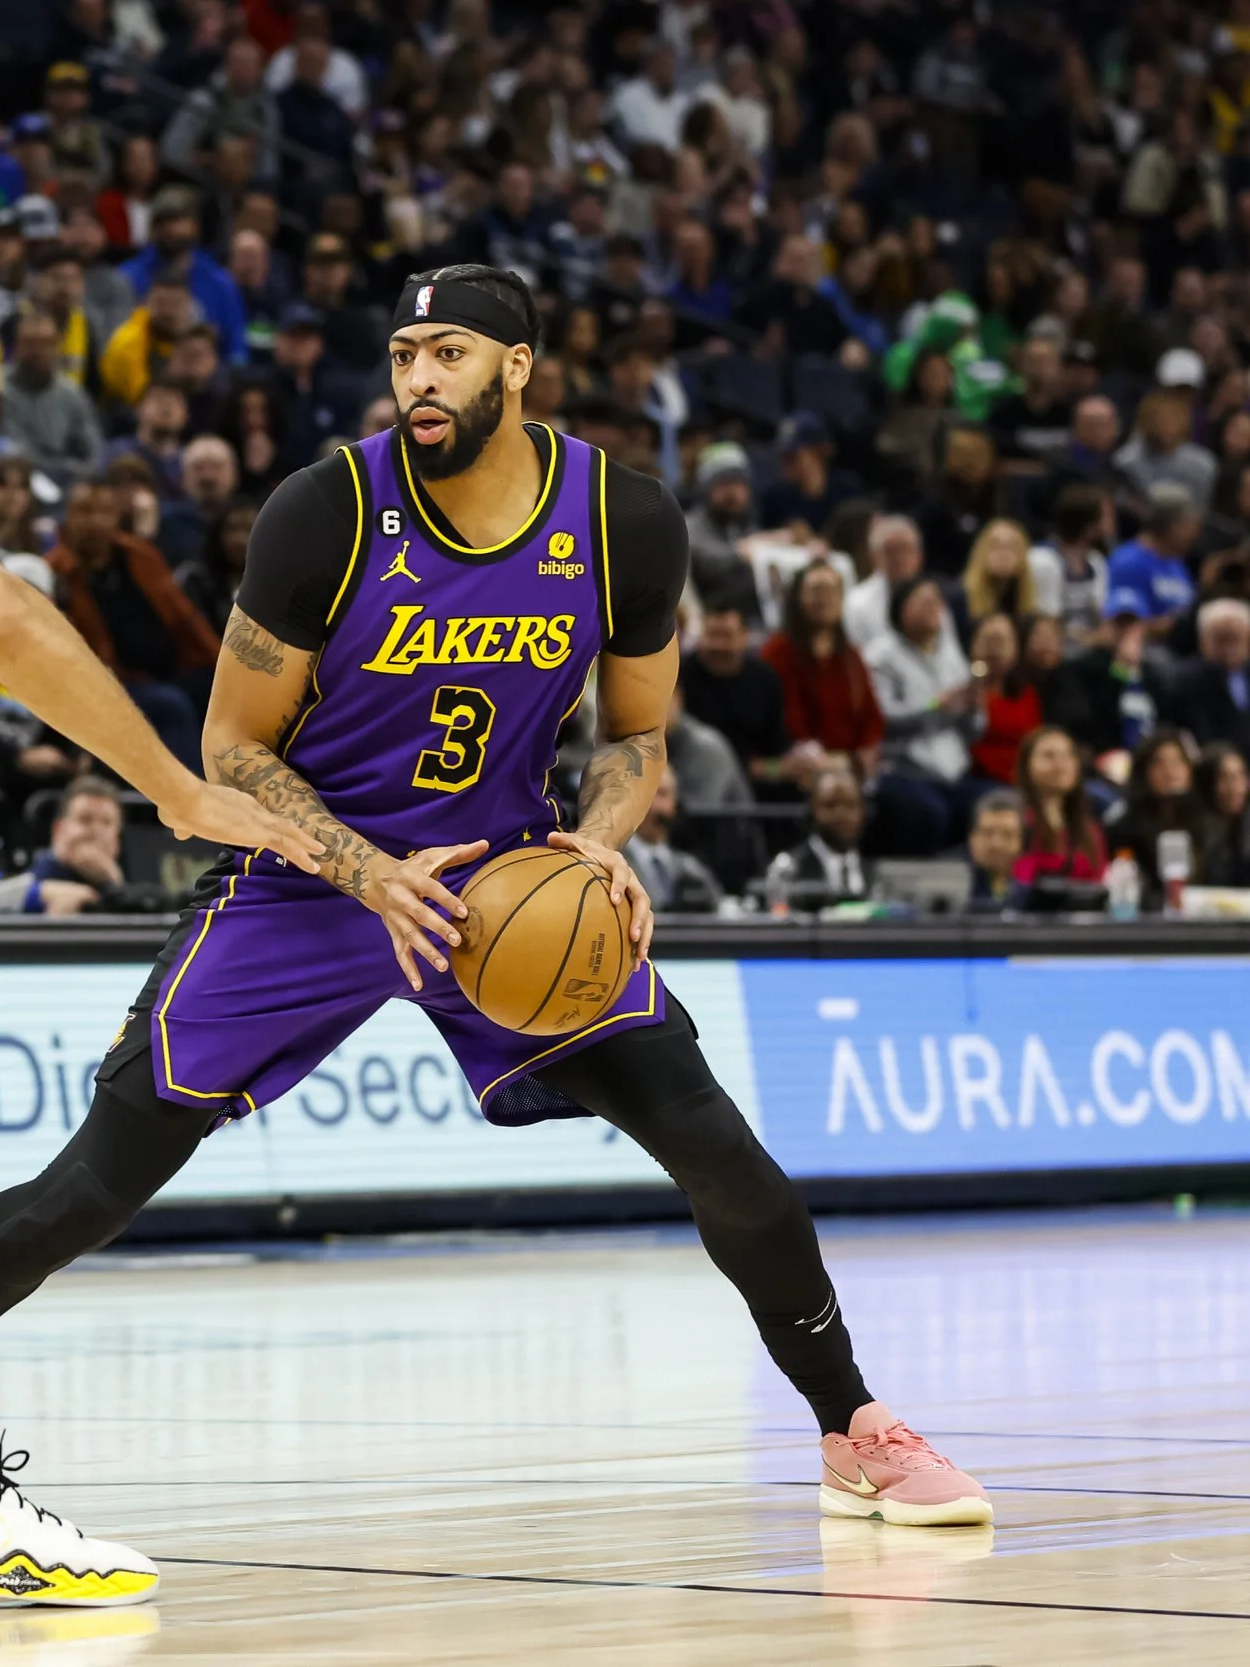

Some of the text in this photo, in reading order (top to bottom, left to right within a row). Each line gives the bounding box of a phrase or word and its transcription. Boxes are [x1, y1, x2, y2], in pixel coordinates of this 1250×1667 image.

[382, 510, 401, 535] 6
[538, 560, 585, 580] bibigo
[360, 605, 576, 675] LAKERS
[411, 685, 497, 794] 3
